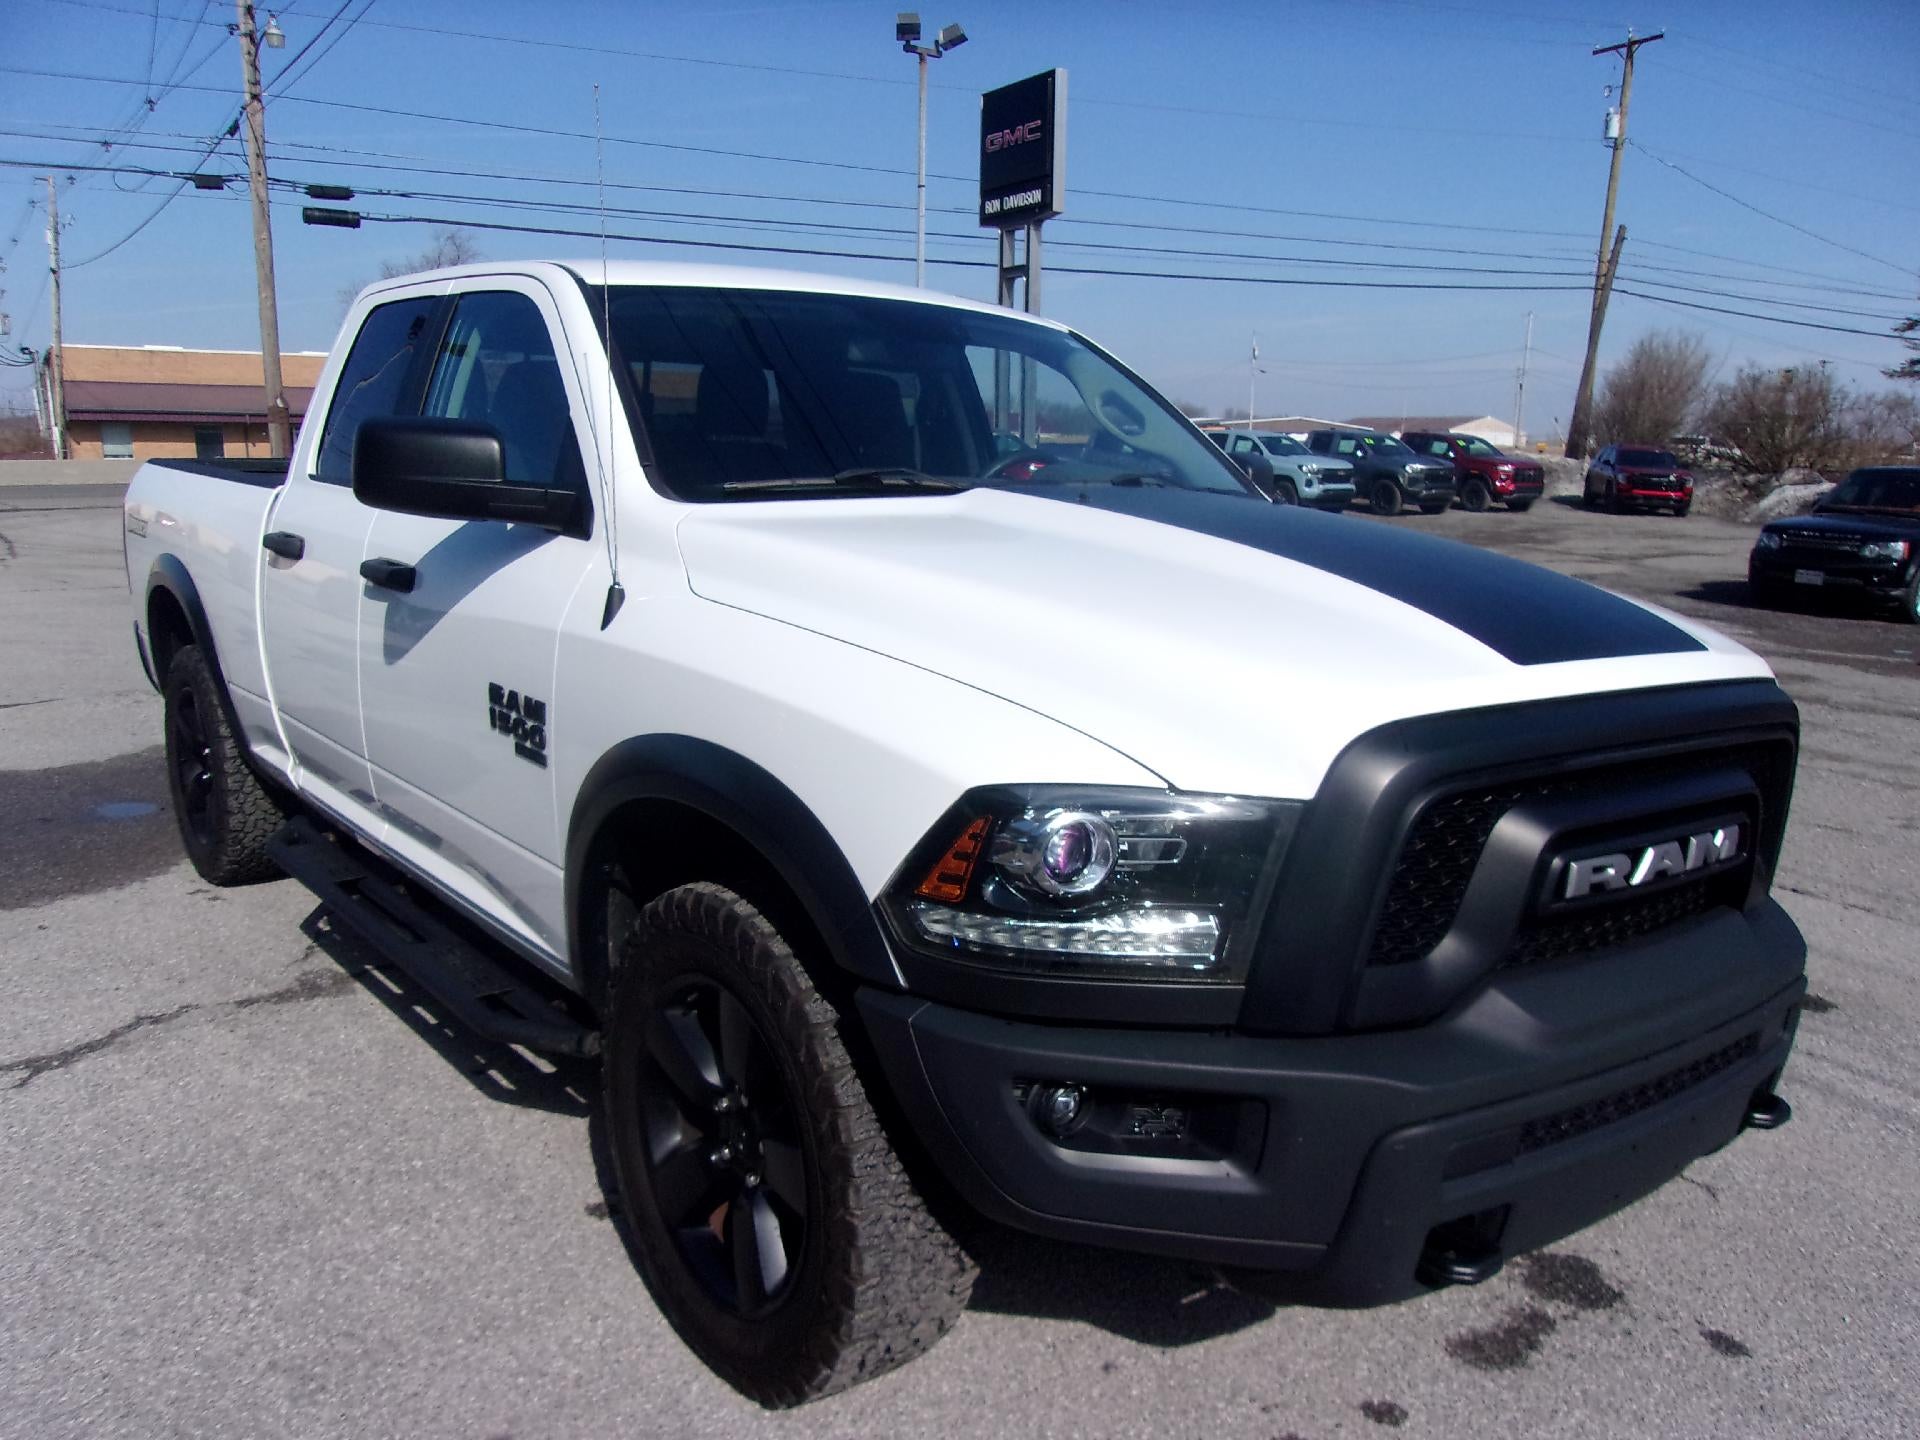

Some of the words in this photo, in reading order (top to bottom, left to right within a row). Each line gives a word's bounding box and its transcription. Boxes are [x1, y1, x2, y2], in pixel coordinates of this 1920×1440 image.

[986, 120, 1041, 153] GMC
[985, 198, 1000, 214] RON
[1003, 189, 1041, 210] DAVIDSON
[488, 681, 546, 726] RAM
[489, 705, 546, 751] 1500
[1565, 824, 1740, 899] RAM
